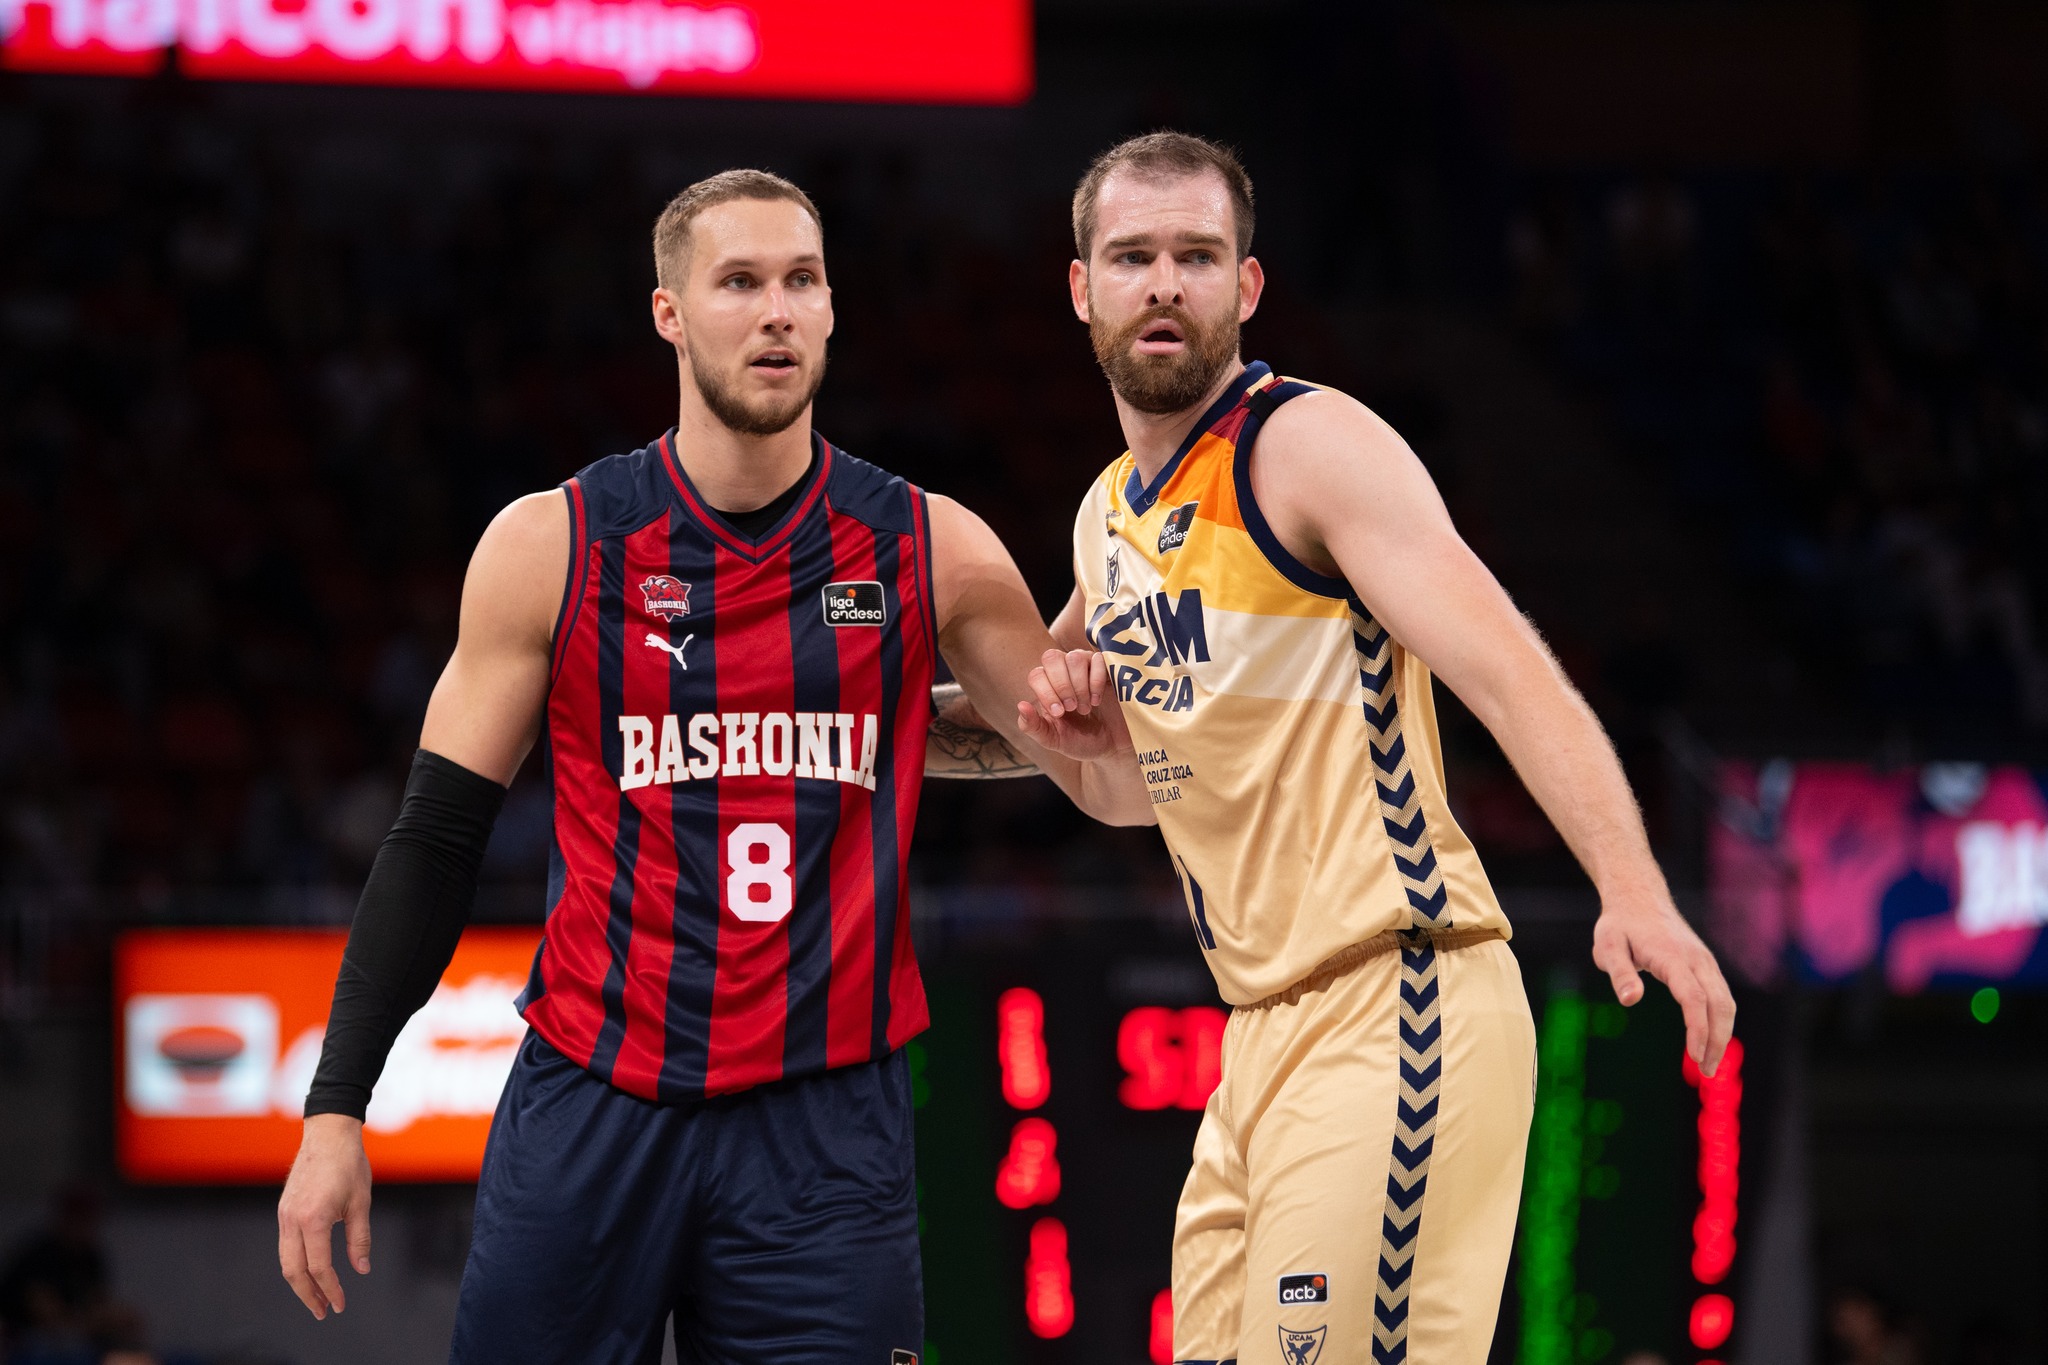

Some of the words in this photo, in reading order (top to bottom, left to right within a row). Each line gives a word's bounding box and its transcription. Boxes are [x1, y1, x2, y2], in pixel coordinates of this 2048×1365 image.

[647, 600, 687, 611] BASKONIA
[830, 596, 854, 609] liga
[831, 608, 882, 620] endesa
[618, 712, 878, 792] BASKONIA
[1147, 768, 1171, 784] CRUZ
[1171, 765, 1193, 780] 2024
[1148, 786, 1182, 805] UBILAR
[727, 823, 793, 922] 8
[1282, 1285, 1317, 1301] acb
[1288, 1334, 1313, 1342] UCAM
